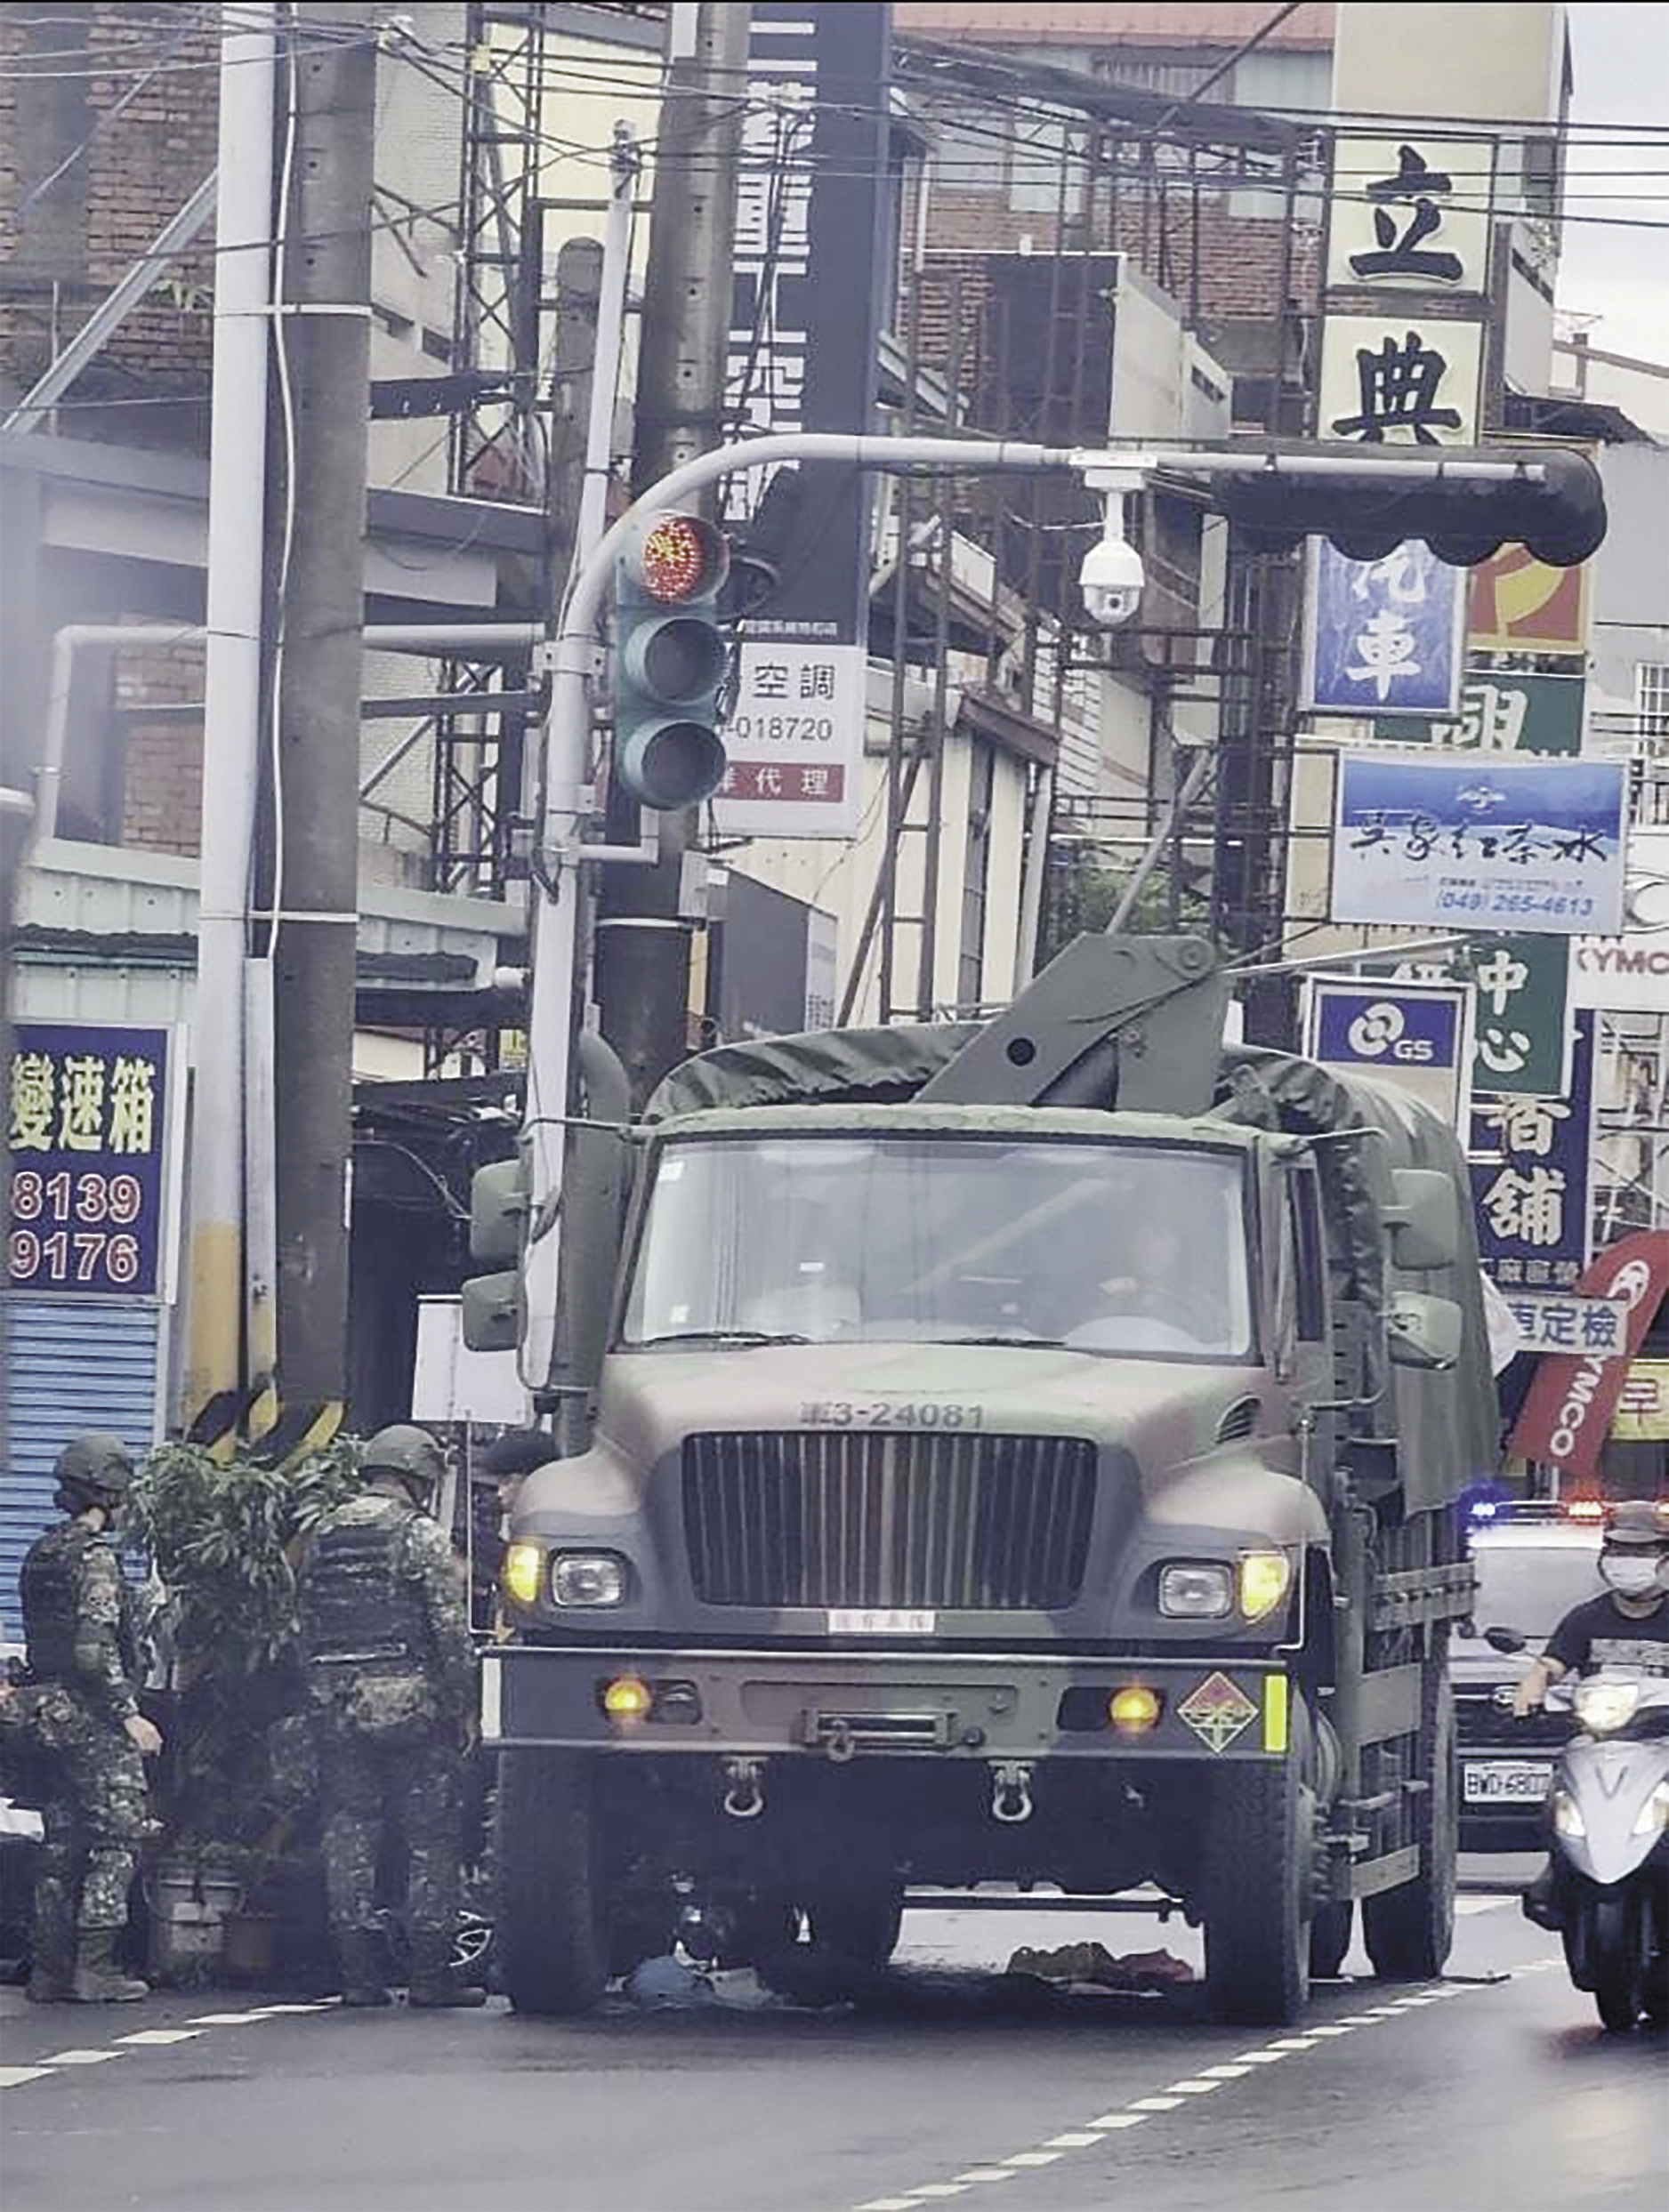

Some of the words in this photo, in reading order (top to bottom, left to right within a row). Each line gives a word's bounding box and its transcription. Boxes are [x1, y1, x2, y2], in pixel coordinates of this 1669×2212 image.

[1331, 144, 1464, 446] 立典
[753, 663, 836, 701] 空調
[1477, 949, 1531, 1073] 中心
[1393, 1039, 1434, 1061] GS
[9, 1052, 156, 1154] 變速箱
[12, 1170, 141, 1224] 8139
[9, 1229, 139, 1283] 9176
[1619, 1378, 1663, 1426] 早
